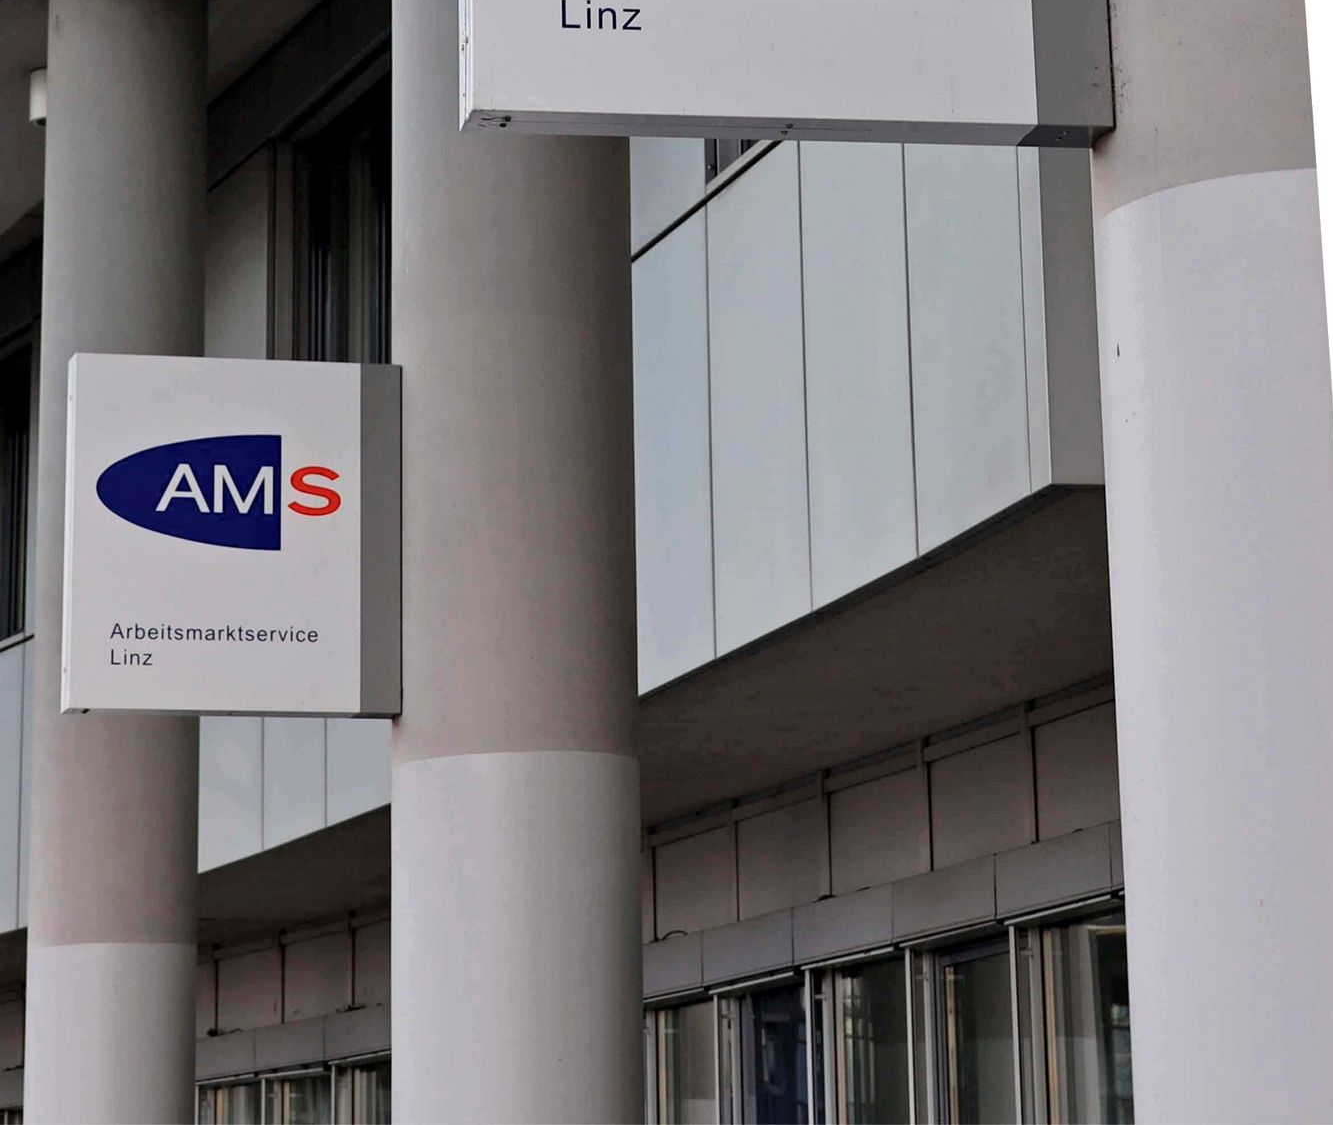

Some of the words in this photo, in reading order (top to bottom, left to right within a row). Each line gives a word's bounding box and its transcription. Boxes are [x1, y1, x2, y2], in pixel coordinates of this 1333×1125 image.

[560, 0, 642, 30] Linz
[155, 463, 342, 516] AMS
[110, 623, 319, 643] Arbeitsmarktservice
[110, 648, 153, 666] Linz
